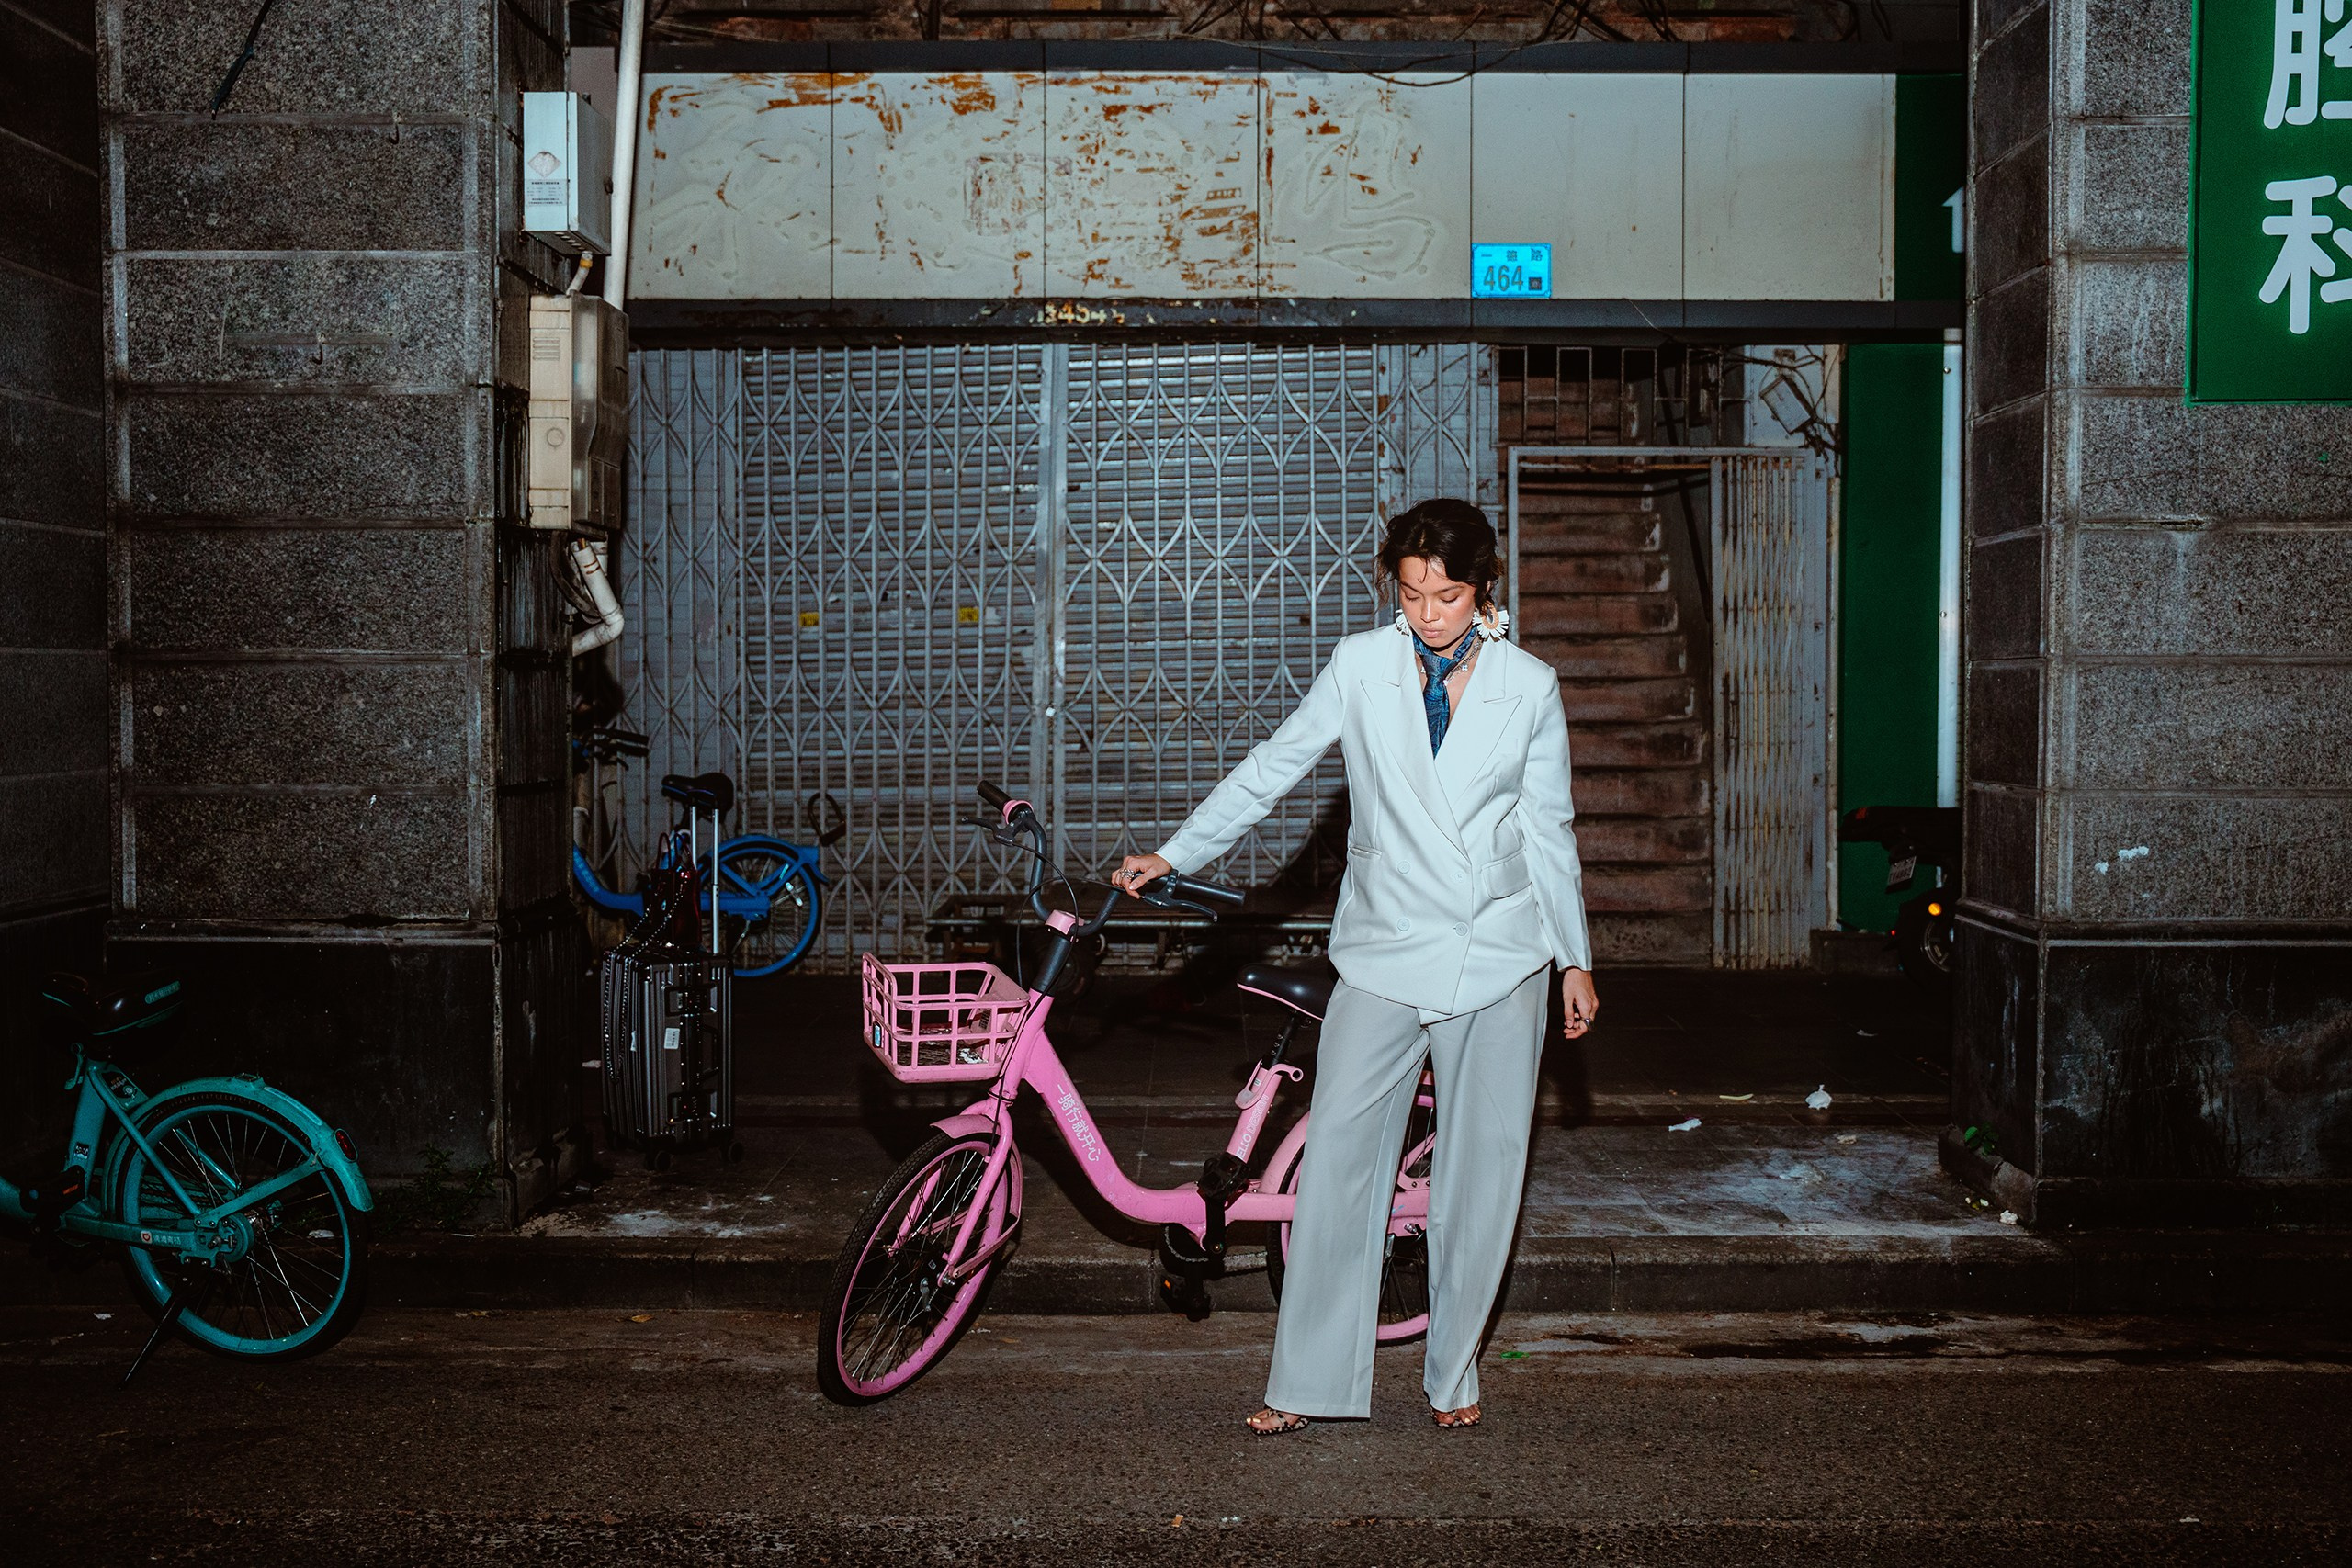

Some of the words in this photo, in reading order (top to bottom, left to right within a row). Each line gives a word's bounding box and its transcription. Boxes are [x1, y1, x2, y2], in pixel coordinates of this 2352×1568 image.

[1483, 265, 1524, 292] 464
[1057, 1084, 1101, 1161] 一骑行就开心
[1236, 1133, 1252, 1160] ELLO
[1246, 1093, 1270, 1134] DESIGN
